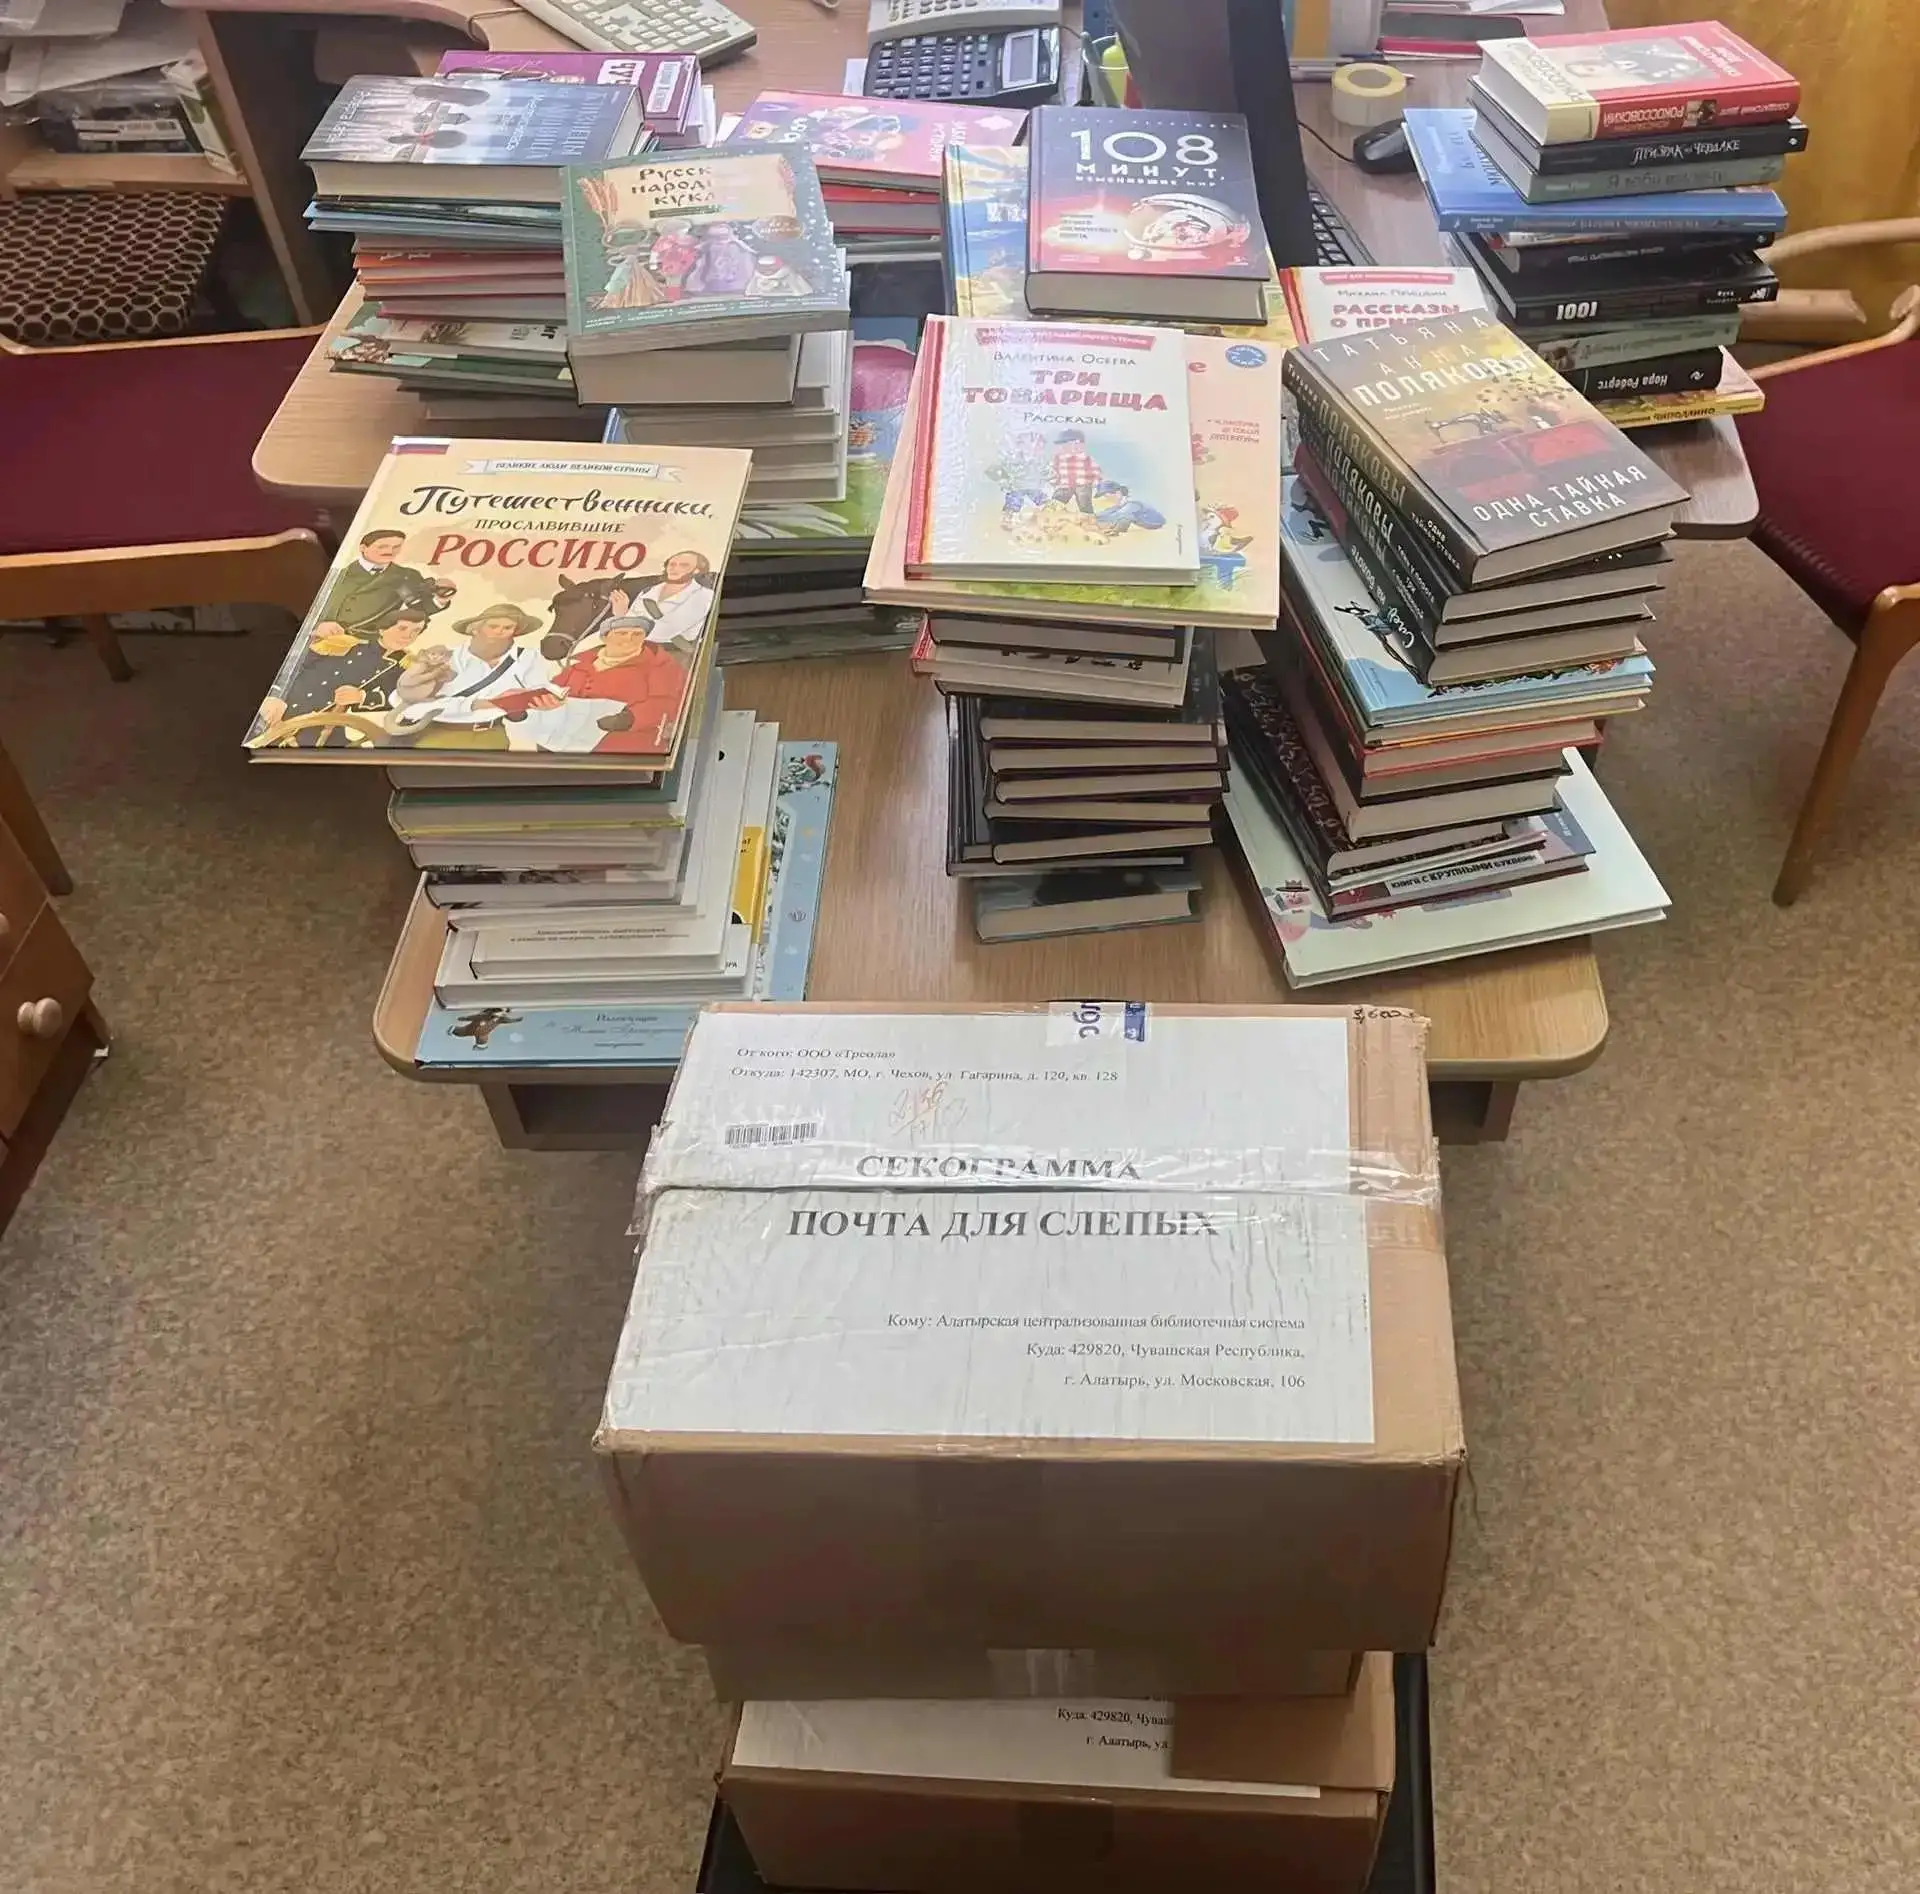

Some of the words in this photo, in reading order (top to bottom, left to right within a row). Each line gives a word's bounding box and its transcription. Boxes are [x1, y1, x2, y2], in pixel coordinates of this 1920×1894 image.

[1071, 128, 1219, 165] 108
[1632, 146, 1684, 166] ПРИЗРАК
[1694, 140, 1741, 156] ЧЕРДАКЕ
[1076, 163, 1225, 180] МИНУТ,
[1332, 303, 1460, 316] РАССКАЗЫ
[1556, 301, 1598, 321] 1001
[1330, 318, 1346, 329] О
[1314, 315, 1489, 363] ТАТЬЯНА
[1379, 343, 1476, 374] АННА
[1031, 370, 1101, 386] ТРИ
[1353, 352, 1541, 406] ПОЛЯКОВЫ
[1597, 376, 1639, 391] Робертс
[1639, 374, 1668, 389] Нора
[963, 387, 1168, 412] ТОВАРИЩА
[1024, 412, 1107, 425] РАССКАЗЫ
[1318, 399, 1407, 503] ПОЛЯКОВЫ
[1472, 493, 1544, 522] ОДНА
[1548, 464, 1648, 504] ТАЙНАЯ
[400, 485, 714, 519] Путешественники,
[1528, 492, 1627, 529] СТАВКА
[475, 518, 626, 533] ПРОСЛАВИВШИЕ
[427, 534, 647, 571] РОССИЮ
[797, 1048, 832, 1058] ООО
[790, 1068, 839, 1079] 142307,
[1096, 1071, 1119, 1081] 128
[856, 1155, 1142, 1180] СЕКОГРАММА
[786, 1211, 931, 1237] ПОЧТА
[941, 1211, 1027, 1242] ДЛЯ
[1040, 1211, 1219, 1238] СЛЕПЫХ
[887, 1314, 932, 1329] Кому:
[936, 1314, 1019, 1329] Алатырская
[1024, 1315, 1147, 1329] централизованная
[1151, 1314, 1246, 1329] библиотечная
[1249, 1318, 1305, 1329] система
[1026, 1343, 1065, 1358] Куда:
[1069, 1344, 1126, 1358] 429820,
[1131, 1344, 1210, 1358] Чувашская
[1215, 1344, 1305, 1360] Республика,
[1064, 1375, 1076, 1385] г.
[1080, 1374, 1151, 1389] Алатырь,
[1154, 1376, 1175, 1388] ул.
[1181, 1374, 1275, 1388] Московская,
[1280, 1375, 1305, 1387] 106
[1090, 1710, 1133, 1724] 429820,
[1099, 1735, 1151, 1749] Алатырь,
